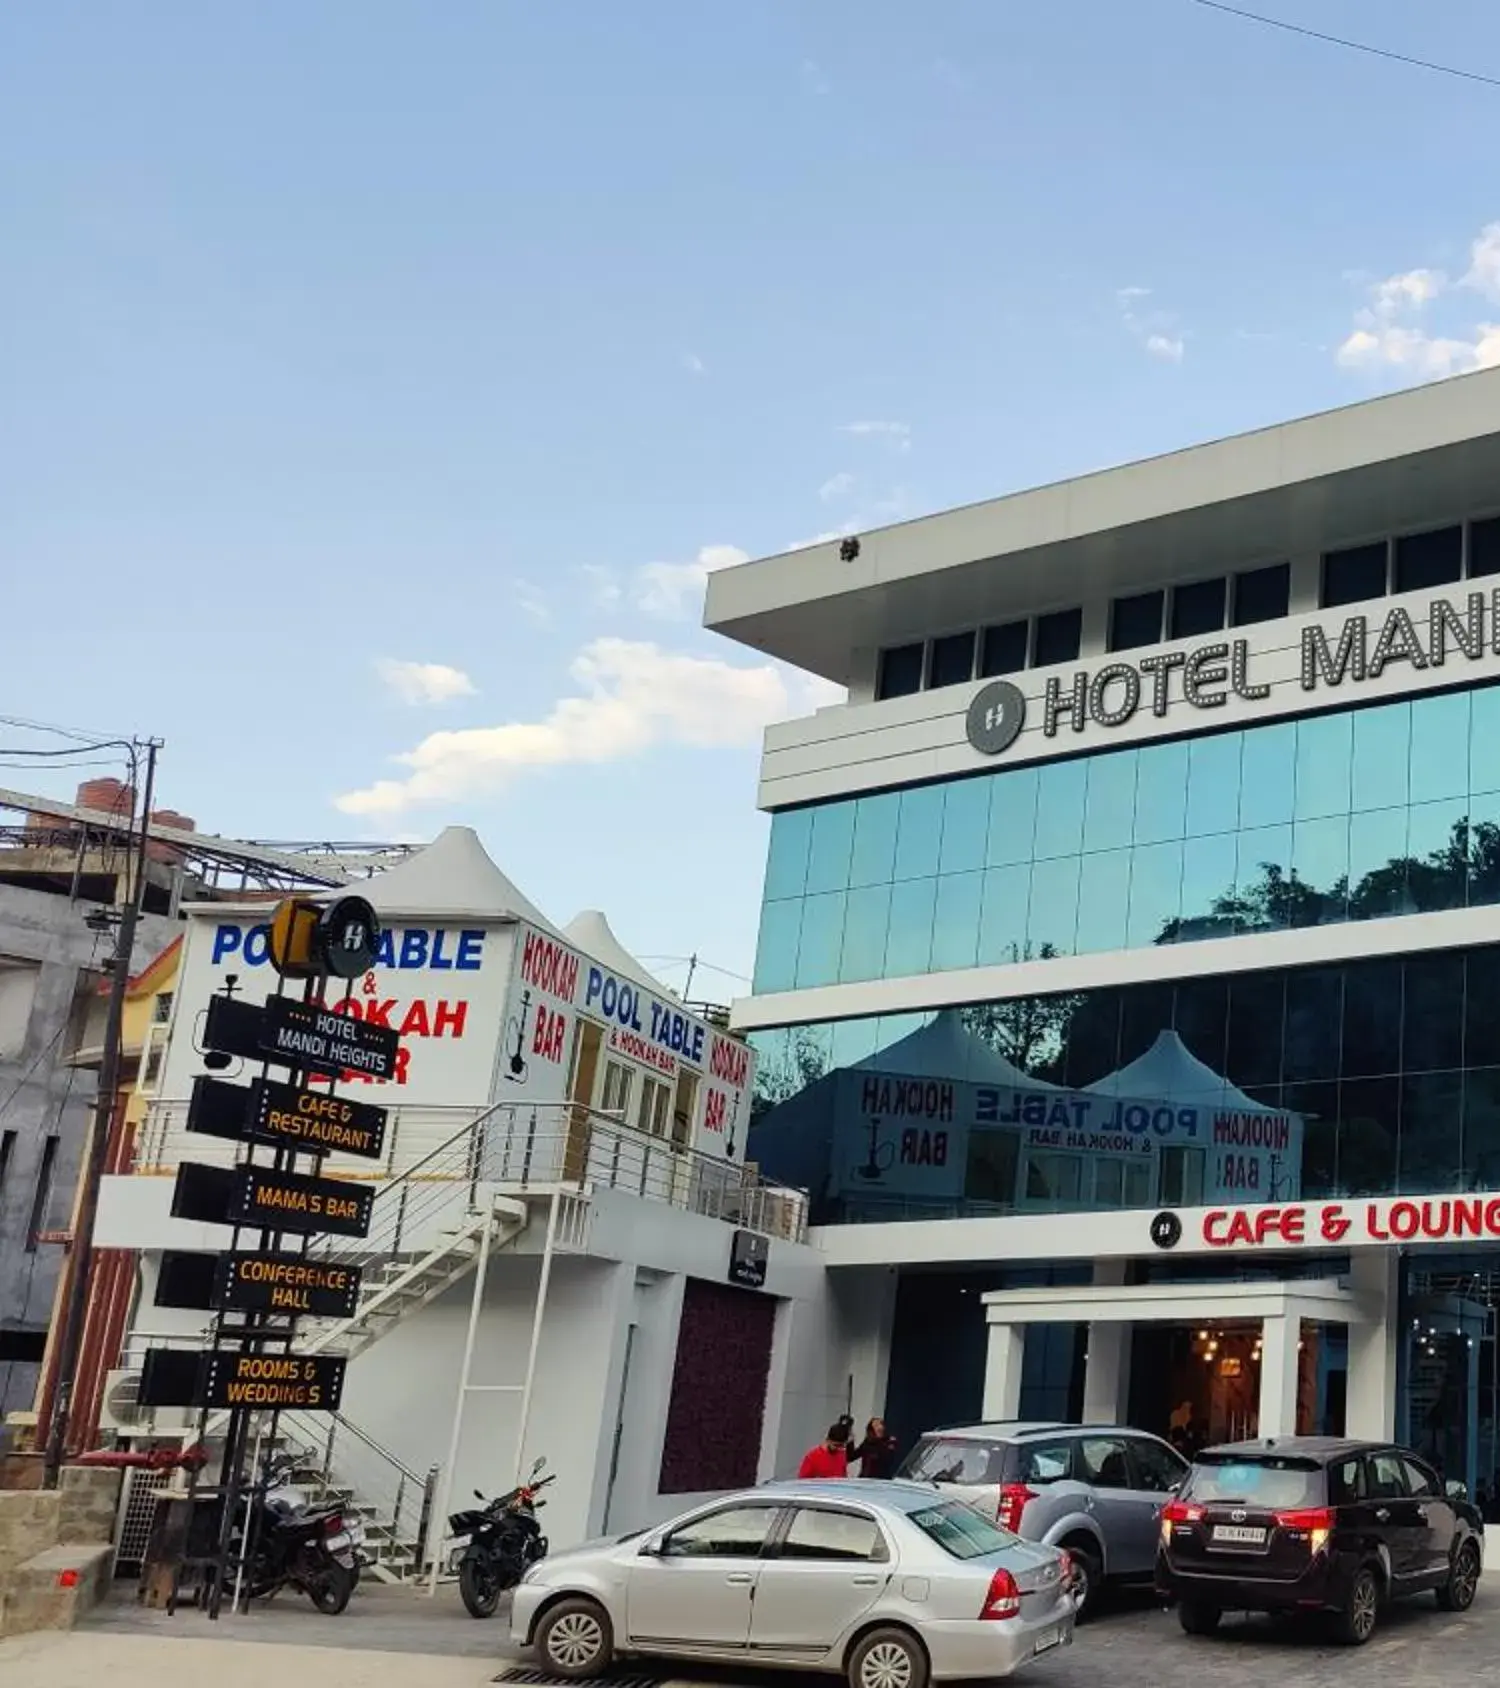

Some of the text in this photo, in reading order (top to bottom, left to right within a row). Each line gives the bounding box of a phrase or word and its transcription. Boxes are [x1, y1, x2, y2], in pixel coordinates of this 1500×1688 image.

[1043, 638, 1270, 737] HOTEL
[376, 928, 488, 970] ABLE
[521, 931, 580, 1004] HOOKAH
[362, 971, 378, 994] &
[315, 1013, 359, 1042] HOTEL
[533, 1005, 566, 1064] BAR
[585, 967, 705, 1063] POOL TABLE
[276, 1027, 328, 1055] MANDI
[329, 1043, 387, 1071] HEIGHTS
[620, 1031, 658, 1065] HOOKAH
[657, 1053, 677, 1074] BAR
[708, 1034, 749, 1088] HOOKAH
[298, 1095, 338, 1121] CAFE
[703, 1088, 726, 1132] BAR
[268, 1111, 373, 1149] RESTAURANT
[256, 1186, 359, 1218] MAMA'S BAR
[1202, 1208, 1306, 1247] CAFE
[1320, 1205, 1352, 1242] &
[239, 1260, 347, 1289] CONFERENCE
[271, 1286, 311, 1309] HALL
[237, 1359, 299, 1380] ROOMS
[227, 1383, 321, 1404] WEDDINGS
